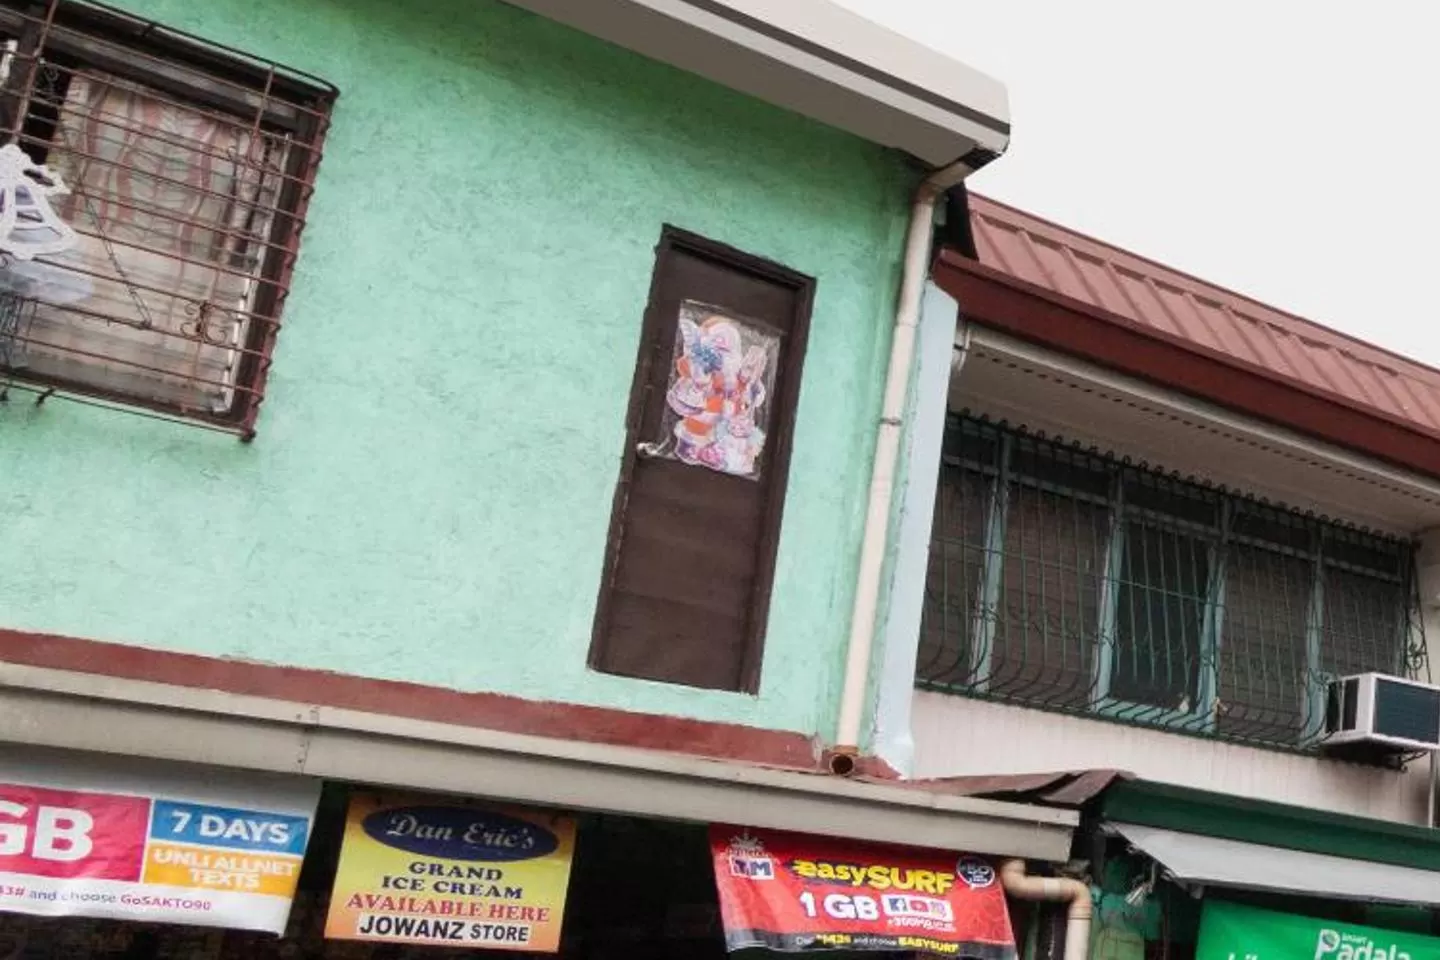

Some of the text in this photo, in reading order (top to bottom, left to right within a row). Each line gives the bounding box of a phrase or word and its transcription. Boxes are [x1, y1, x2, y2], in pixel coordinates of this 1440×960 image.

[171, 811, 289, 844] 7 DAYS
[387, 811, 534, 850] Dan Eric's
[154, 848, 296, 877] UNLI ALLNET
[409, 862, 503, 881] GRAND
[792, 859, 954, 894] easySURF
[191, 867, 260, 888] TEXTS
[382, 875, 523, 900] ICE CREAM
[29, 890, 57, 901] and
[60, 891, 116, 903] choose
[348, 893, 550, 922] AVAILABLE HERE
[800, 891, 879, 920] 1 GB
[360, 915, 529, 942] JOWANZ STORE
